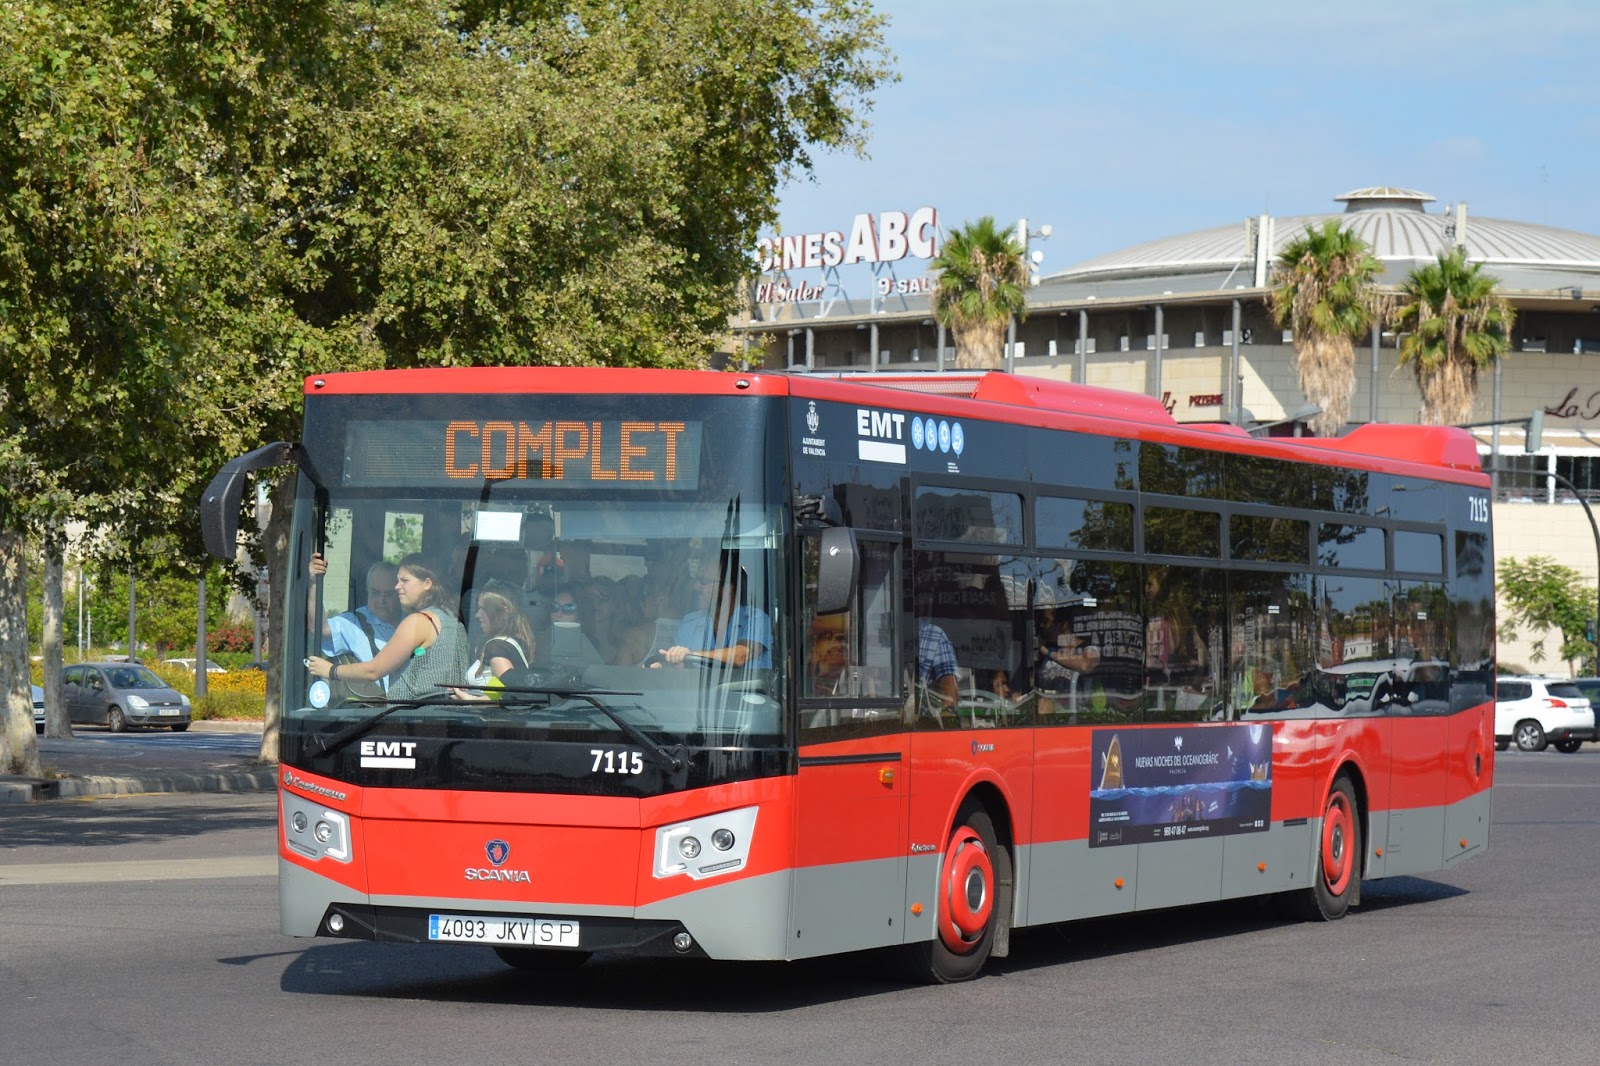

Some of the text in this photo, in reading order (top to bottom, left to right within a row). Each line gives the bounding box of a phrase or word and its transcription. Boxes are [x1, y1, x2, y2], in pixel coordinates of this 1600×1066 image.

[754, 231, 844, 272] CINES
[756, 281, 824, 303] El Saler
[878, 278, 892, 295] 9
[1544, 387, 1579, 418] La
[857, 409, 905, 440] EMT
[445, 421, 686, 481] COMPLET
[1469, 496, 1489, 522] 7115
[361, 741, 416, 757] EMT
[590, 750, 643, 774] 7115
[293, 776, 346, 801] Castrosua
[464, 868, 531, 884] SCANIA
[442, 919, 486, 938] 4093
[497, 921, 529, 941] JKV
